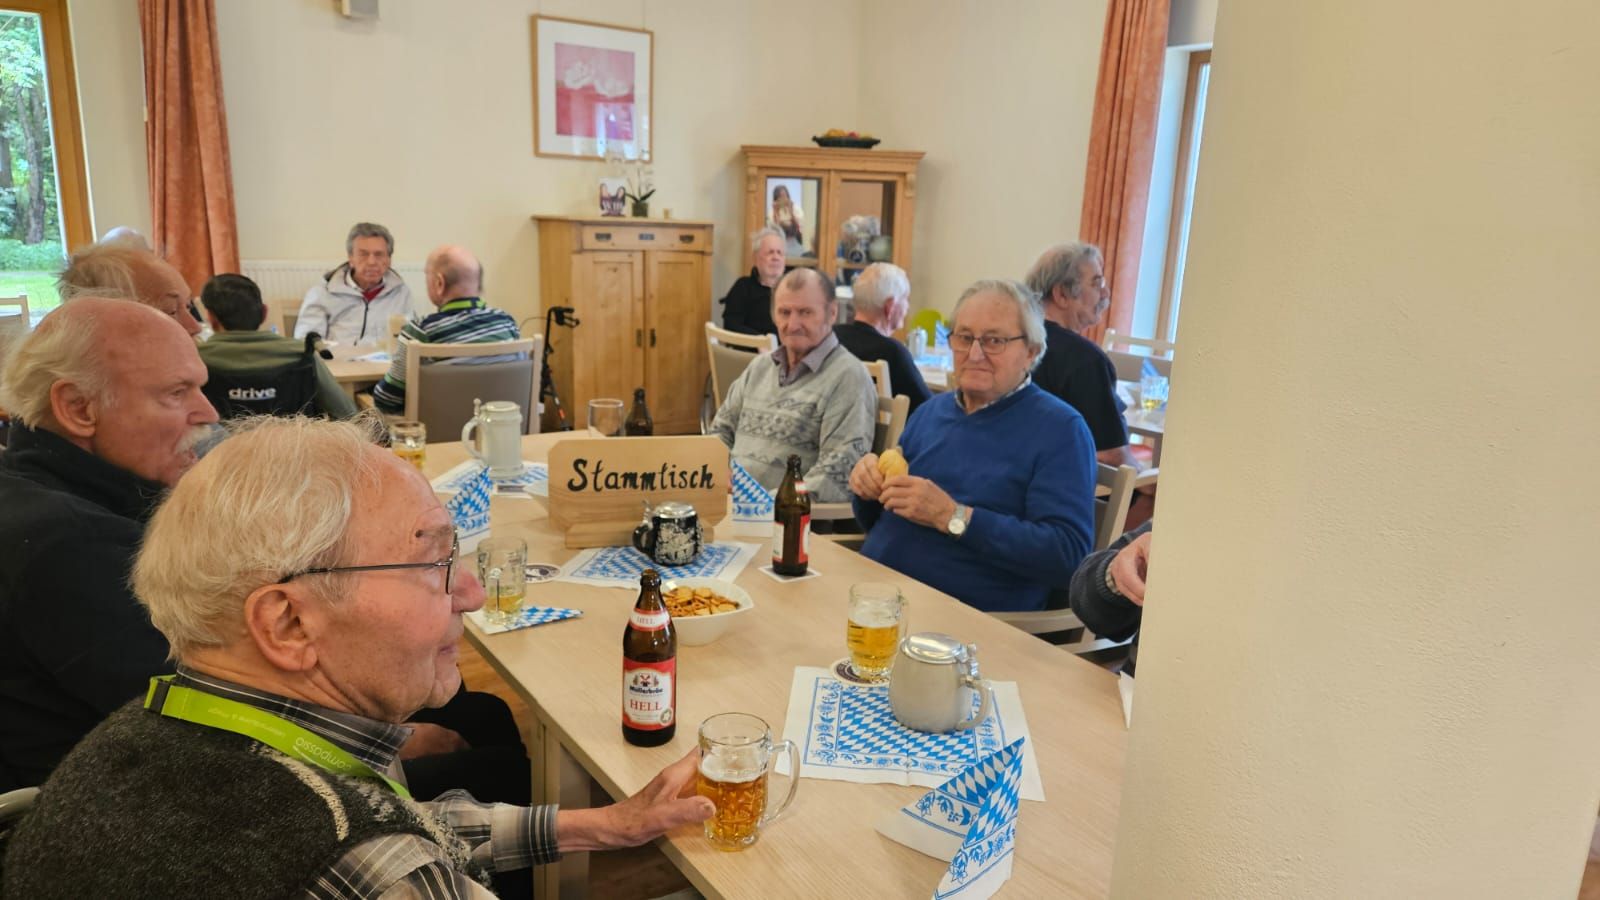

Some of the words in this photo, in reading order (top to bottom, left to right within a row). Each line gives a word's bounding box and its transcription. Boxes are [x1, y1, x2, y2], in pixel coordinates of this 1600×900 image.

[228, 387, 277, 401] drive
[567, 458, 715, 492] Stammtisch
[630, 699, 663, 711] HELL
